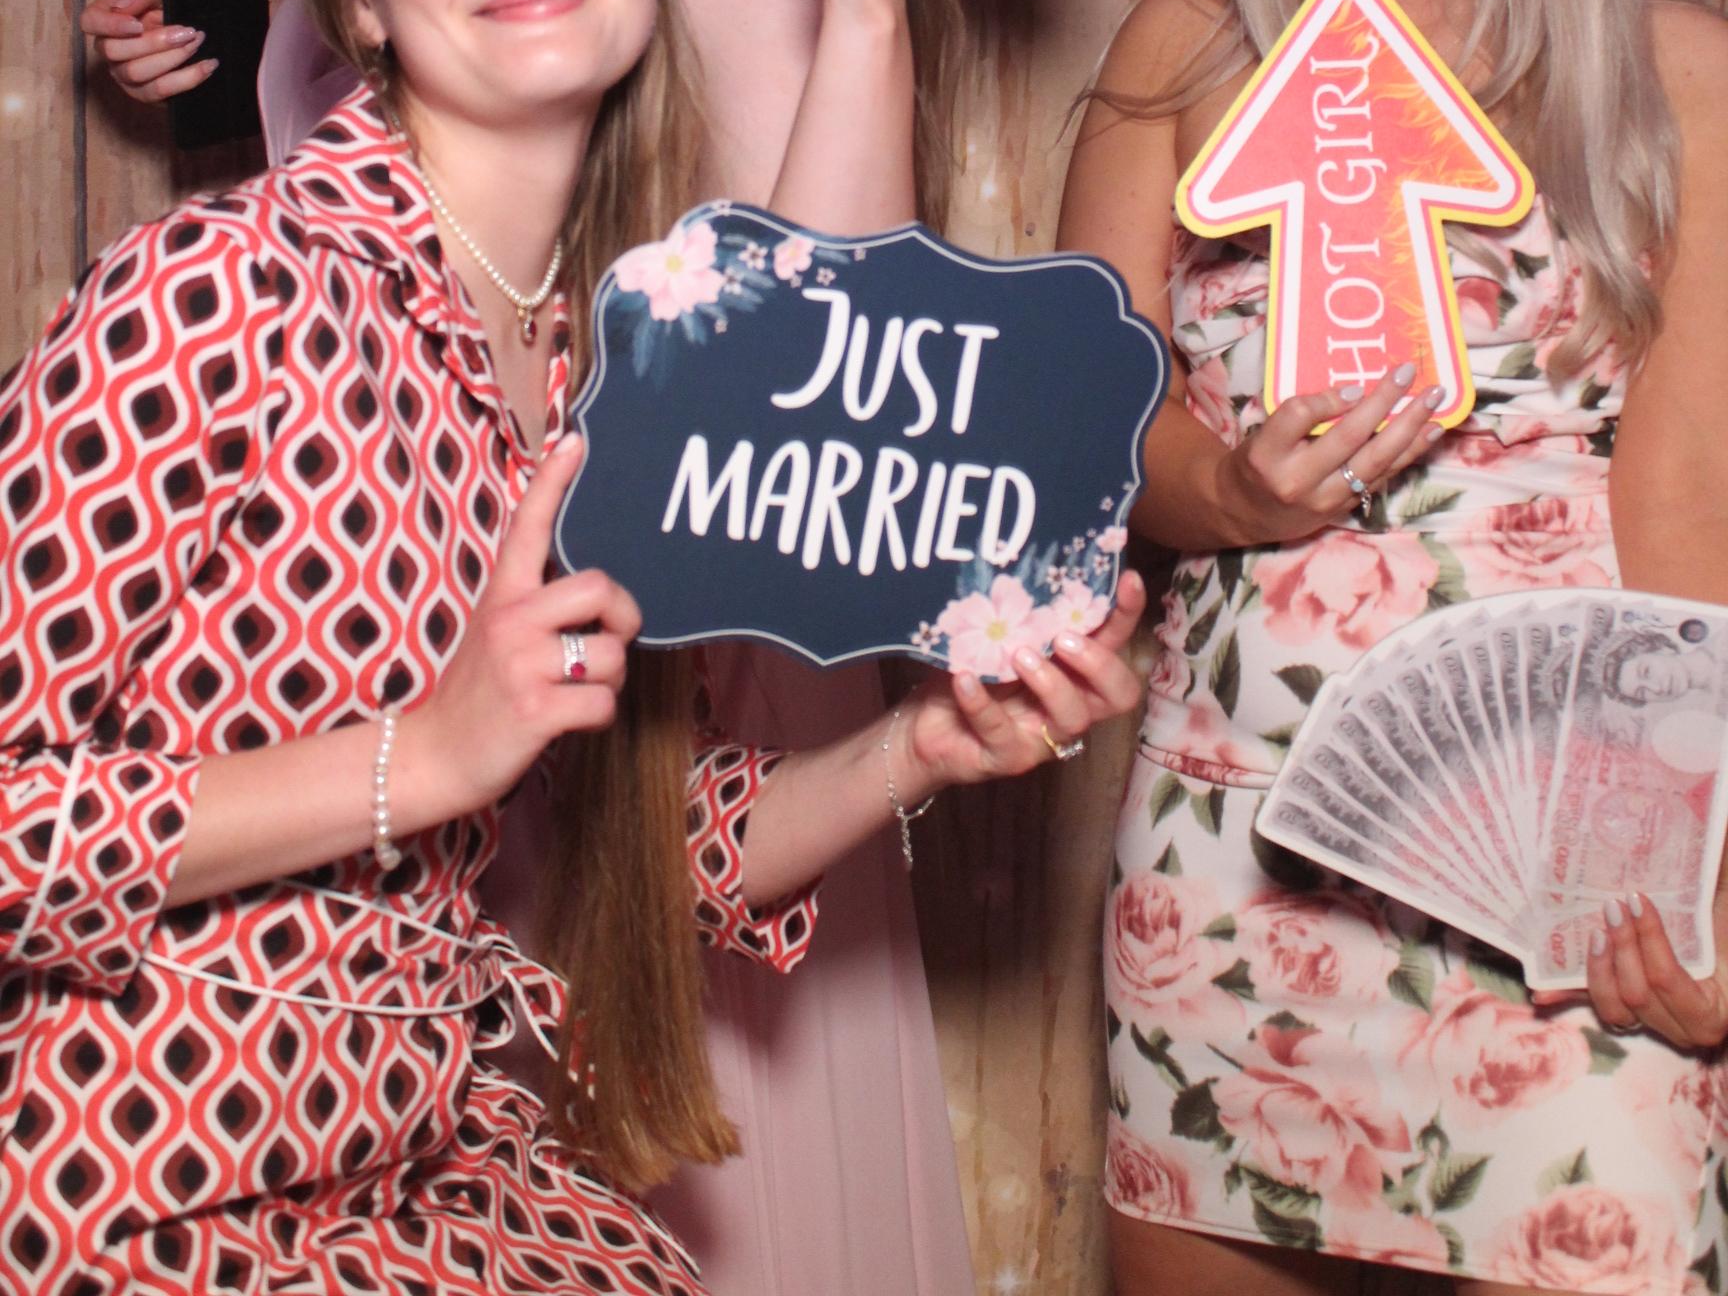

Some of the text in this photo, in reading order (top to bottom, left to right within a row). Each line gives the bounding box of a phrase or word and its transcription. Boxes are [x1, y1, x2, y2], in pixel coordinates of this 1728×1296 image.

[1310, 33, 1388, 387] HOT GIRL
[771, 287, 1000, 437] JUST
[660, 434, 1037, 576] MARRIED
